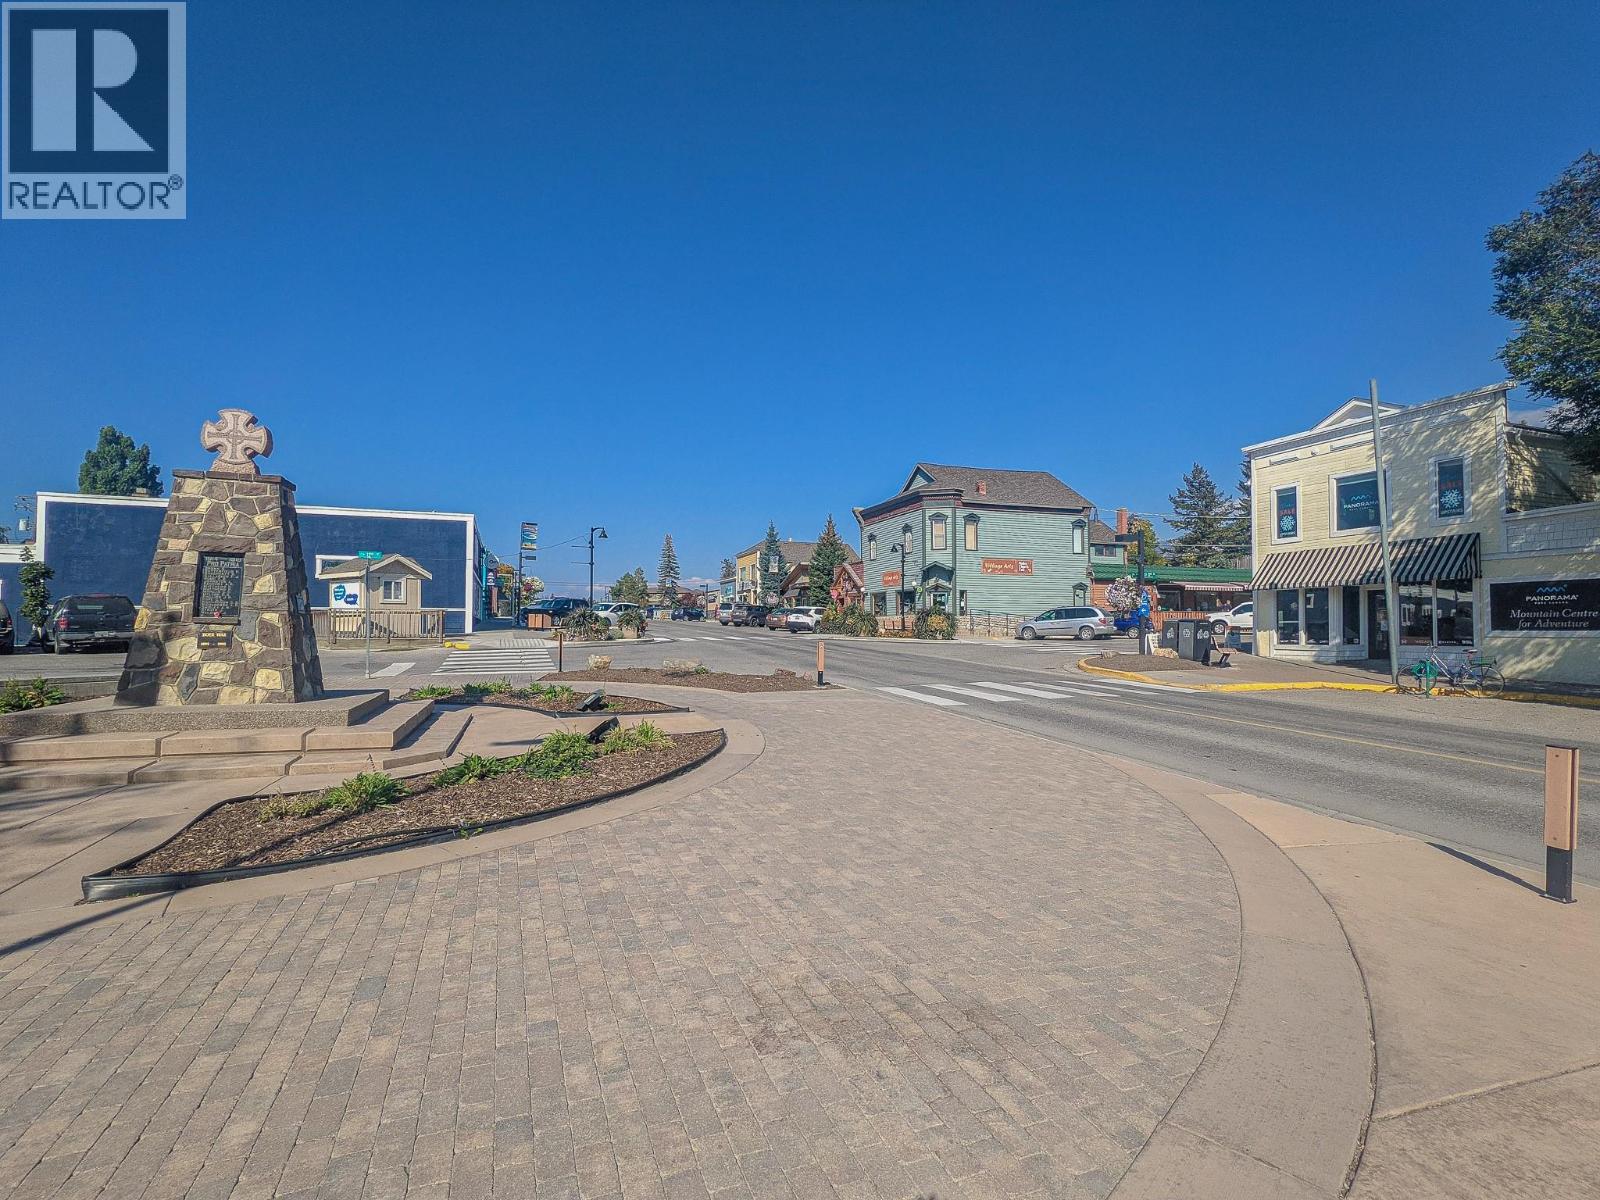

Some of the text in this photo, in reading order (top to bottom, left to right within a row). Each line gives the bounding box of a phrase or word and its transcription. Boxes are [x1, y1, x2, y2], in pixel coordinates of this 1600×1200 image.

[1343, 501, 1379, 509] PANORAMA
[1509, 608, 1599, 618] Mountain Centre
[1518, 619, 1590, 630] for Adventure
